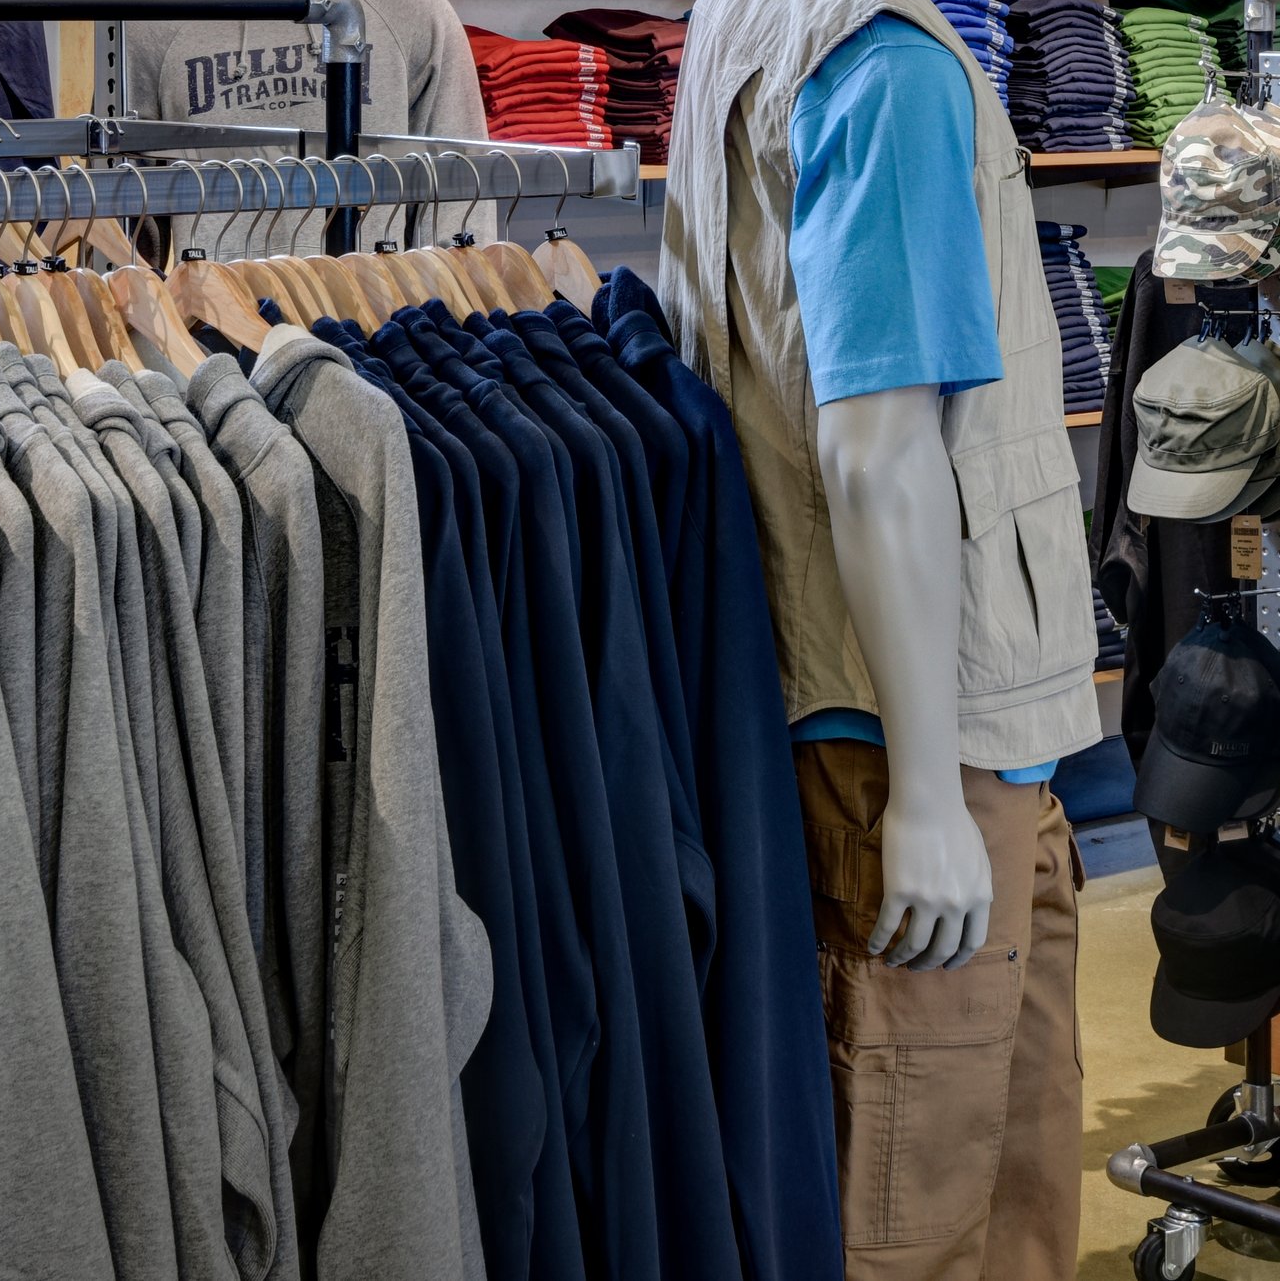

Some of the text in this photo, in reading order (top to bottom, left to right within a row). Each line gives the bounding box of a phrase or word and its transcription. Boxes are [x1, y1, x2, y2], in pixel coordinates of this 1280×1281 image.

[220, 77, 327, 110] TRADIN
[268, 100, 287, 111] CO
[553, 229, 568, 239] TALL
[382, 243, 398, 253] TALL
[187, 249, 204, 259] TALL
